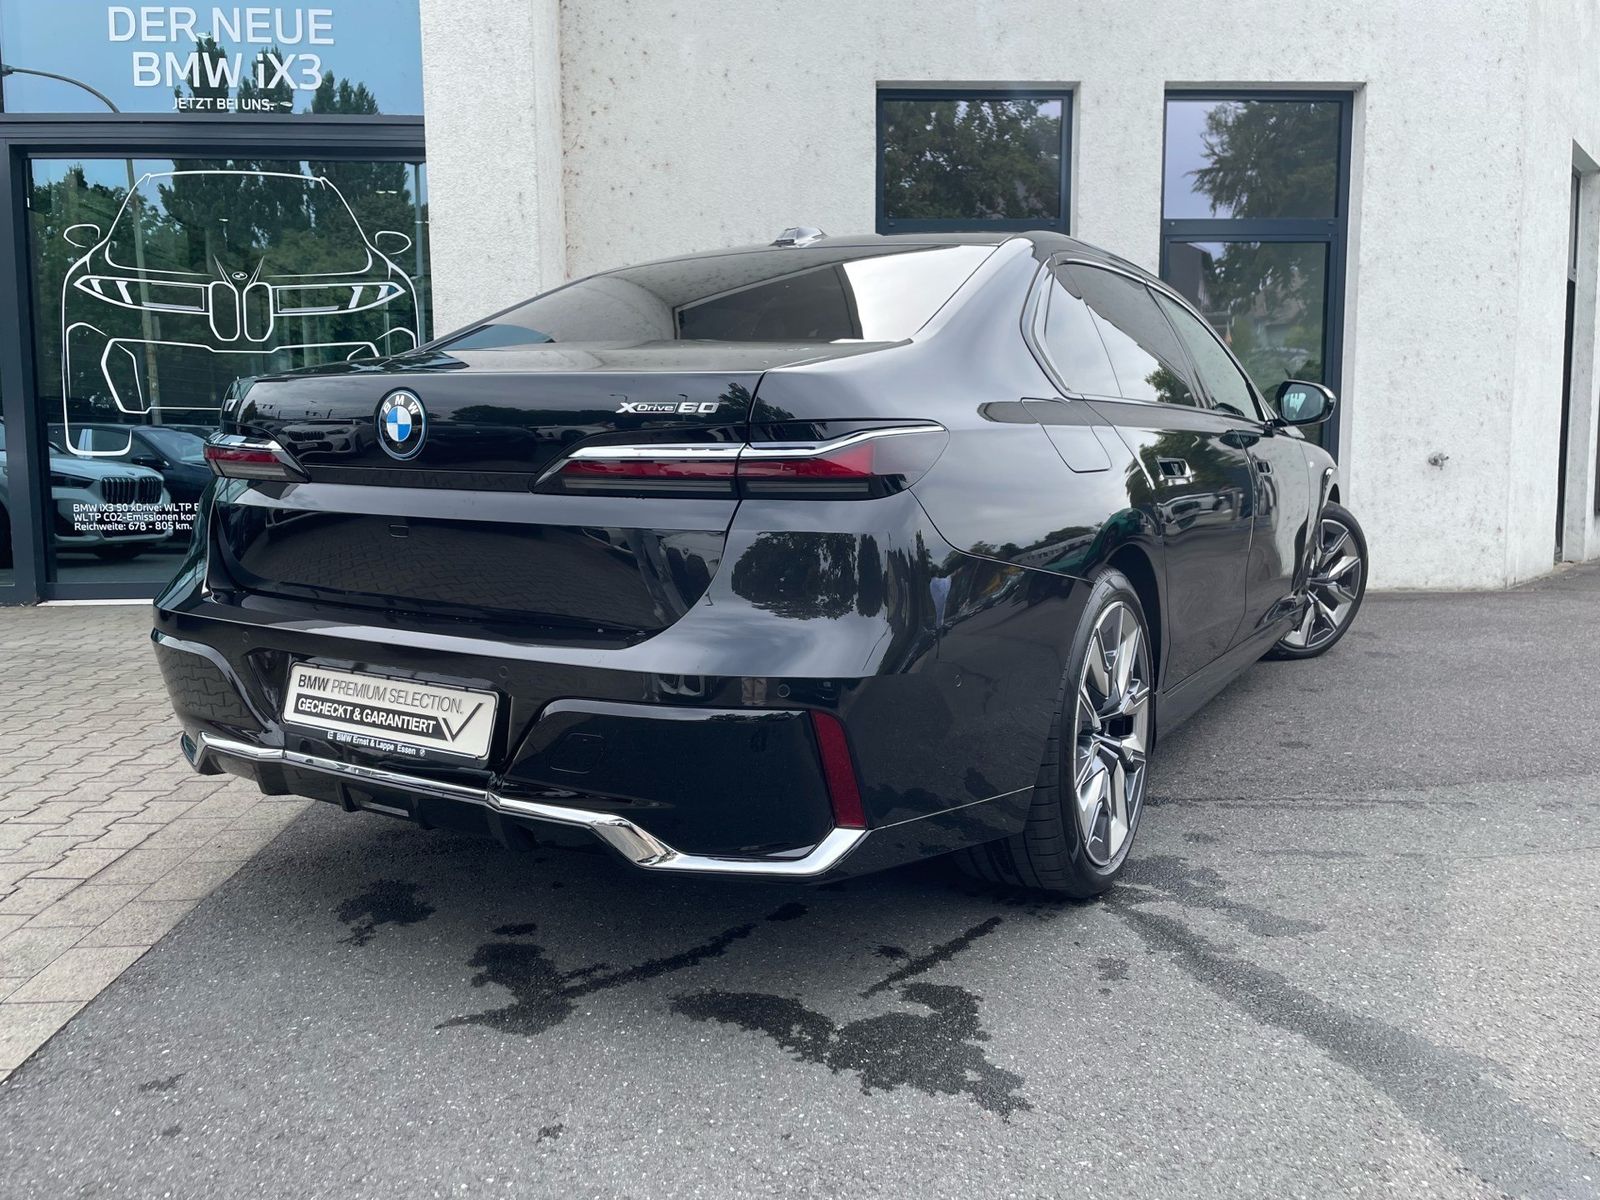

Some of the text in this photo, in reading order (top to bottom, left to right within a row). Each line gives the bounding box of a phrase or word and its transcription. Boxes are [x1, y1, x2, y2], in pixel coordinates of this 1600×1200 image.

[107, 6, 335, 45] DER NEUE
[132, 52, 323, 90] BMW iX3
[172, 97, 214, 110] JETZT
[216, 98, 239, 110] BEI
[382, 394, 419, 415] BMW
[72, 503, 98, 512] BMW
[99, 503, 114, 512] iX3
[116, 503, 128, 512] 50
[130, 503, 163, 512] xDrive:
[164, 502, 192, 512] WLTP
[73, 513, 101, 522] WLTP
[103, 512, 179, 522] CO2-Emissionen
[74, 522, 127, 531] Reichweite:
[128, 522, 147, 531] 678
[154, 521, 174, 531] 805
[175, 521, 193, 530] km.
[298, 674, 463, 714] BMW PREMIUM SELECTION.
[297, 697, 437, 734] GECHECKT & GARANTIERT
[336, 733, 352, 742] BMW
[396, 744, 416, 755] Essen
